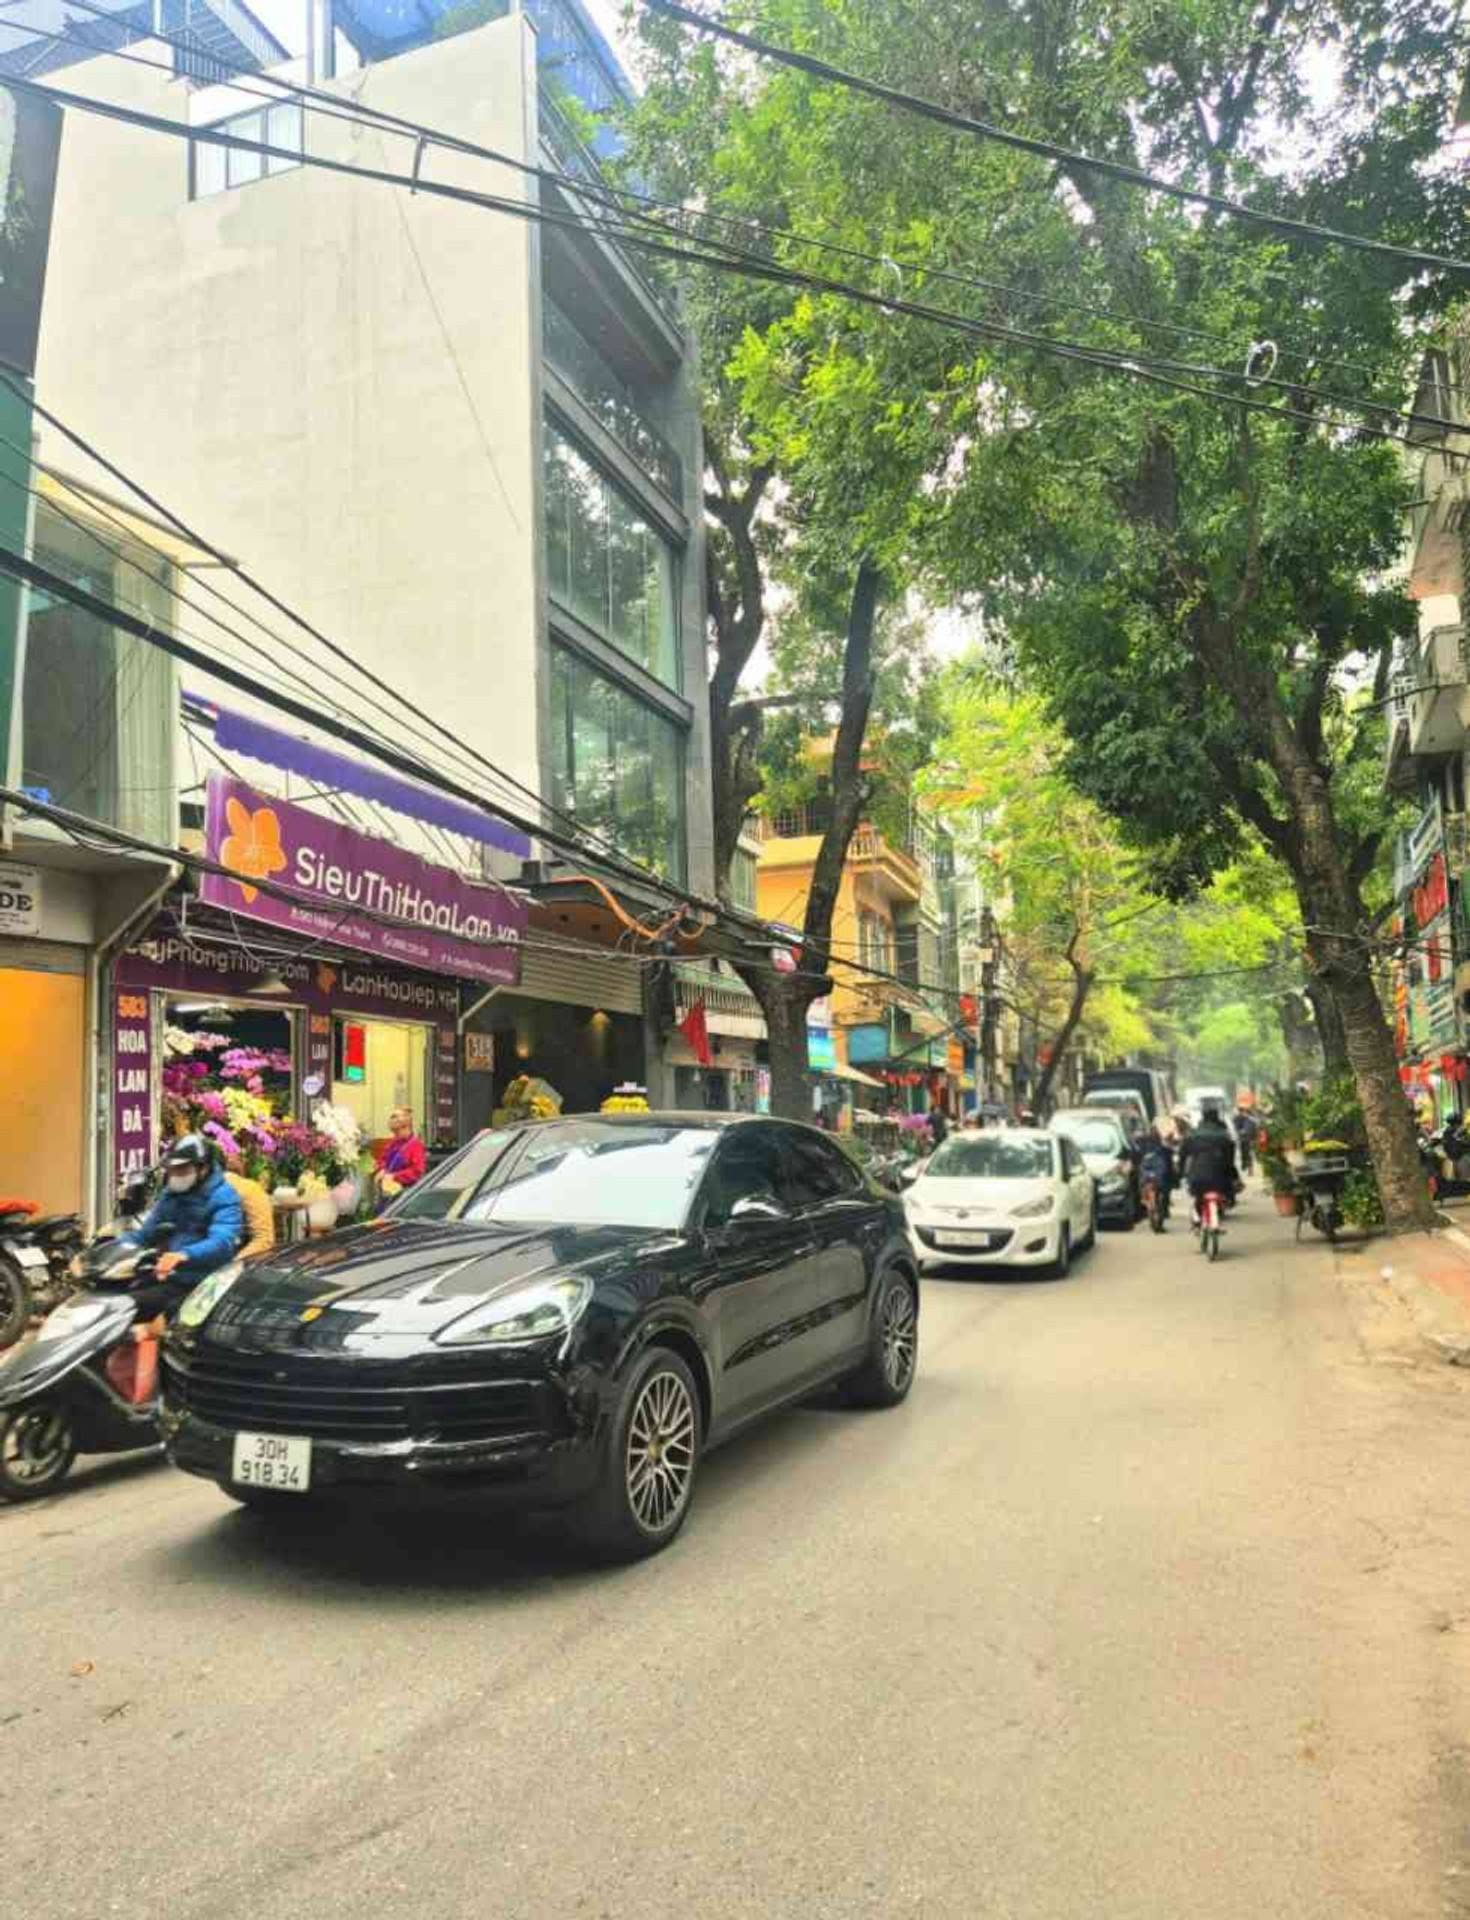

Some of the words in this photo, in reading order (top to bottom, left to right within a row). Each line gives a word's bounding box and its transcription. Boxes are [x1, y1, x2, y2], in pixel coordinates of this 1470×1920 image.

[117, 1029, 147, 1053] HOA
[117, 1069, 147, 1093] LAN
[255, 1438, 288, 1461] 30H
